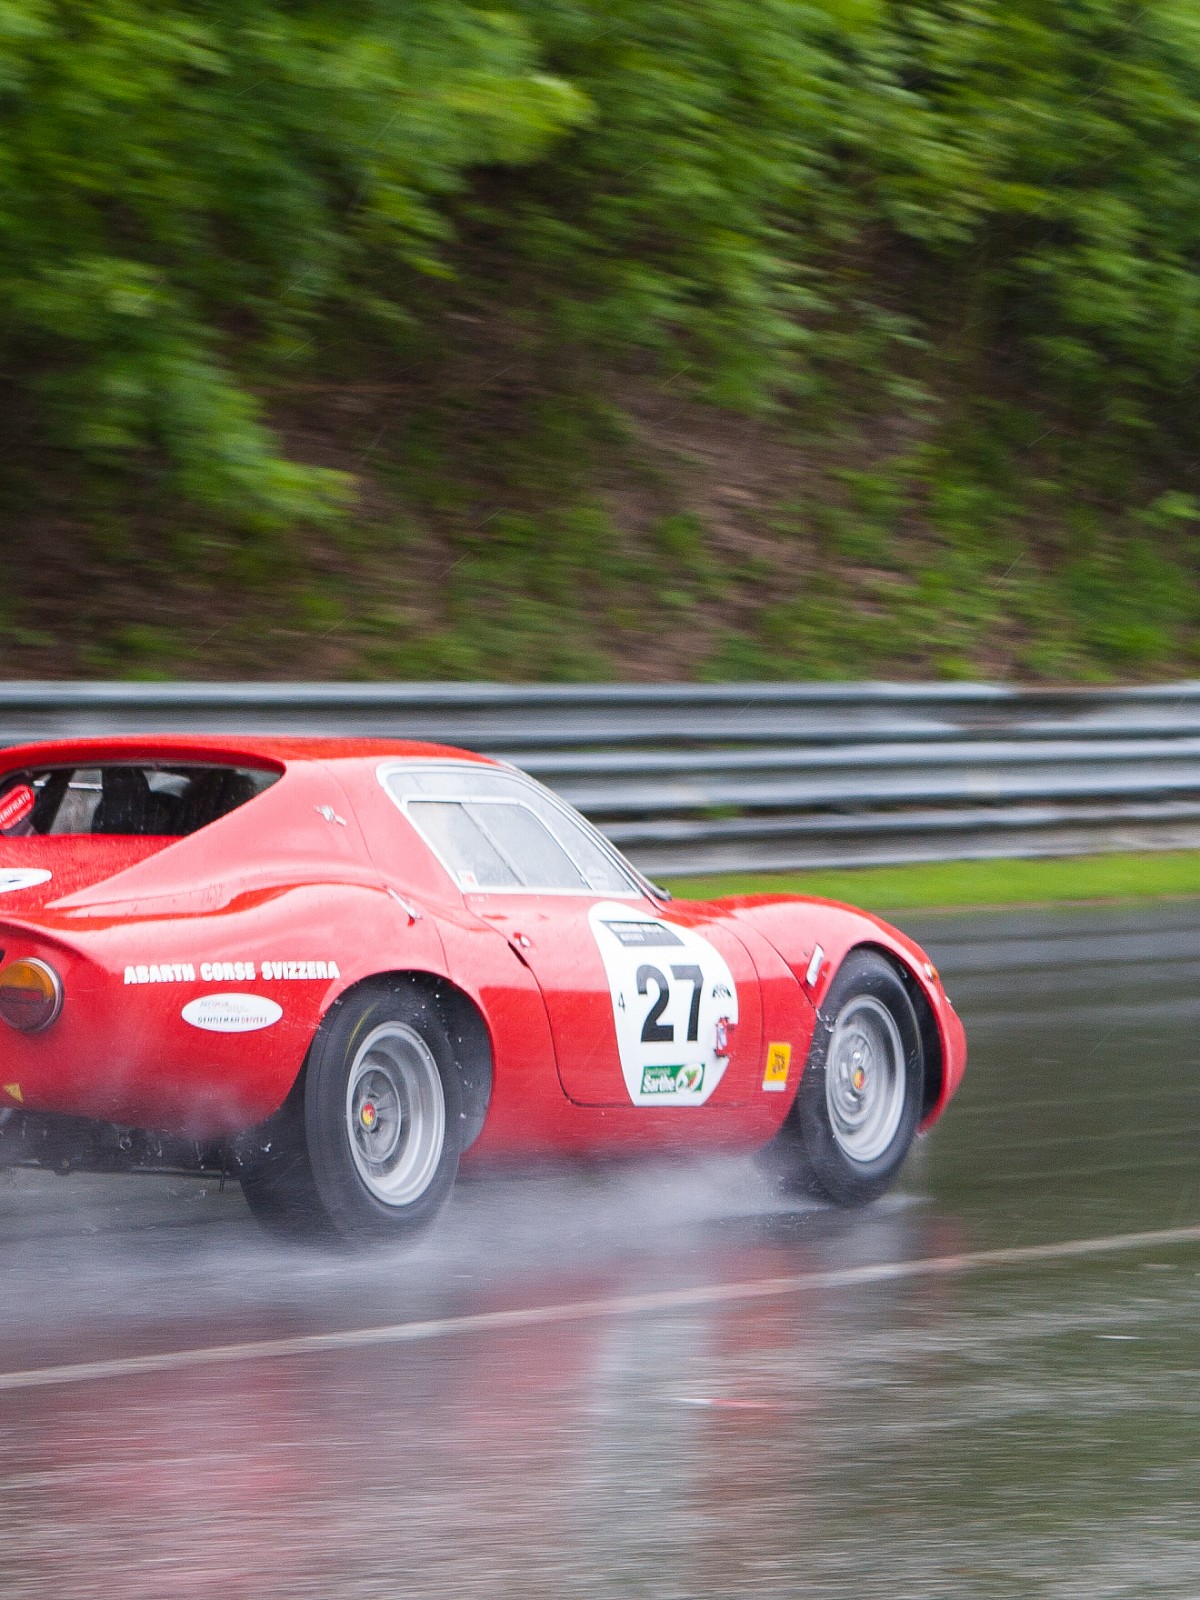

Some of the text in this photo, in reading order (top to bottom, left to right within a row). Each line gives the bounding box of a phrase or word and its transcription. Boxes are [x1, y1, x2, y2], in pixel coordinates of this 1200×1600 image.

[123, 961, 341, 985] ABARTH CORSE SVIZZERA
[636, 964, 704, 1042] 27
[643, 1074, 675, 1093] Sarthe
